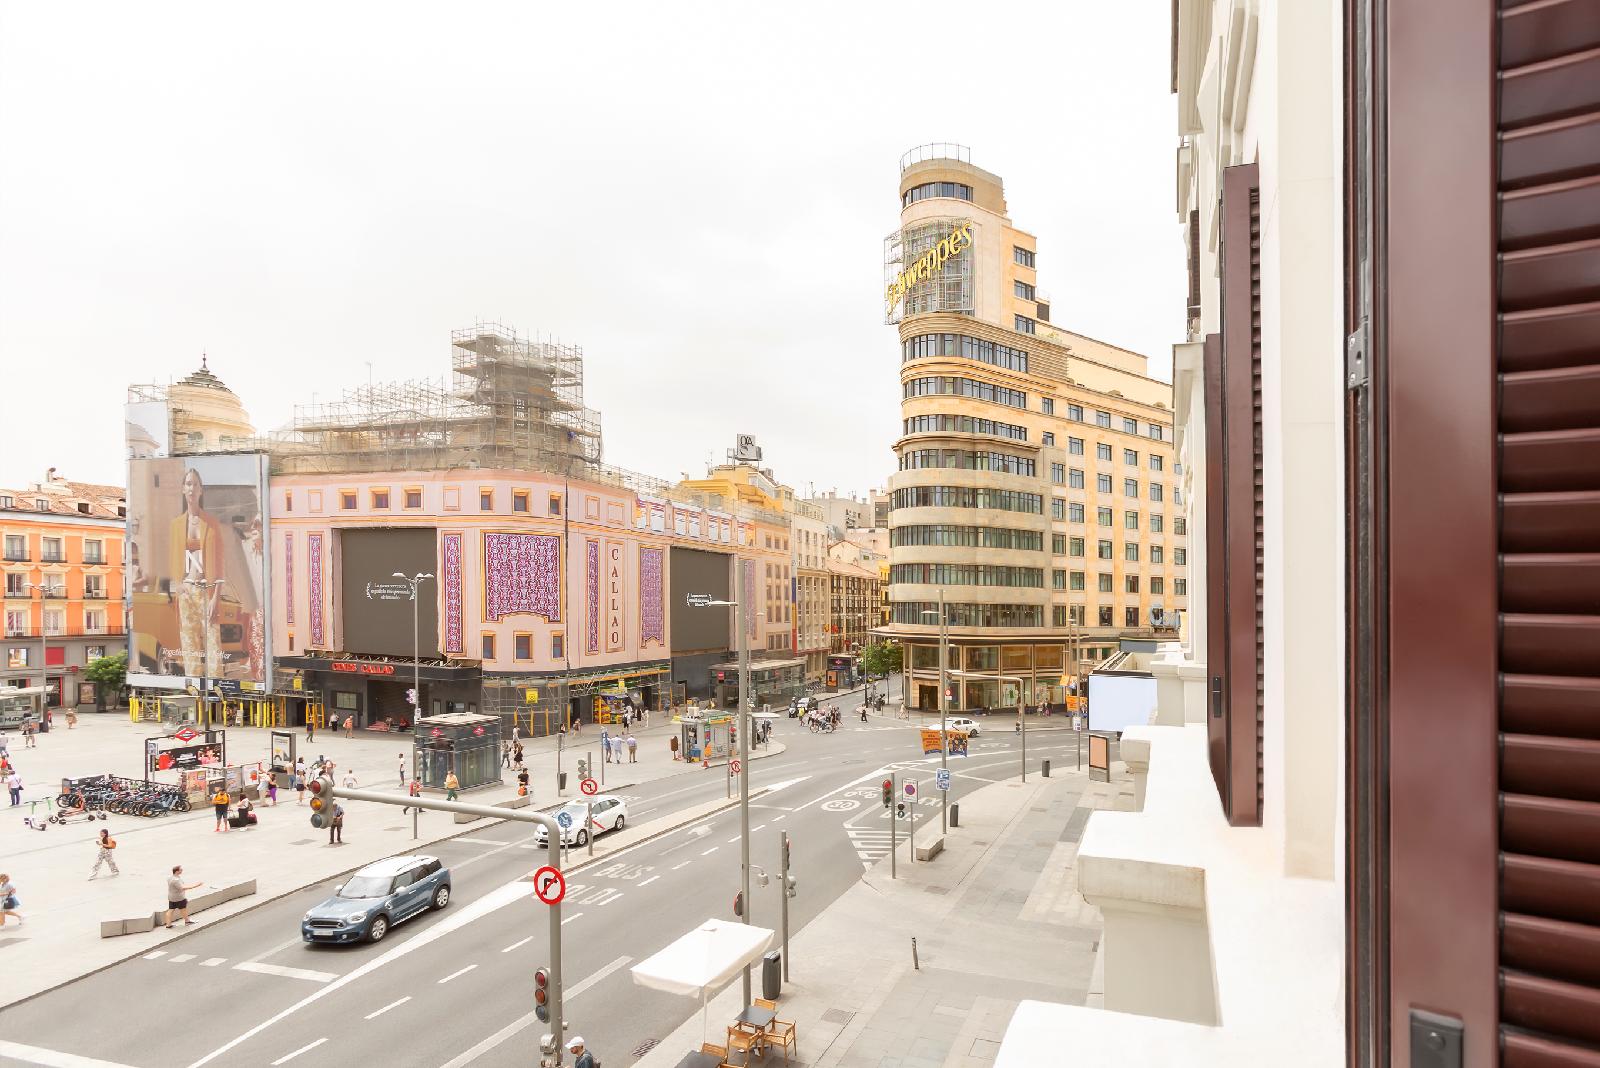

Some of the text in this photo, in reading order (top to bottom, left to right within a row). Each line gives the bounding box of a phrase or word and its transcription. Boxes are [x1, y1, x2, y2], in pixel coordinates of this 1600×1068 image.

[611, 548, 619, 644] CALLAO
[331, 662, 395, 675] CINES CALLAO
[592, 863, 656, 880] BUS
